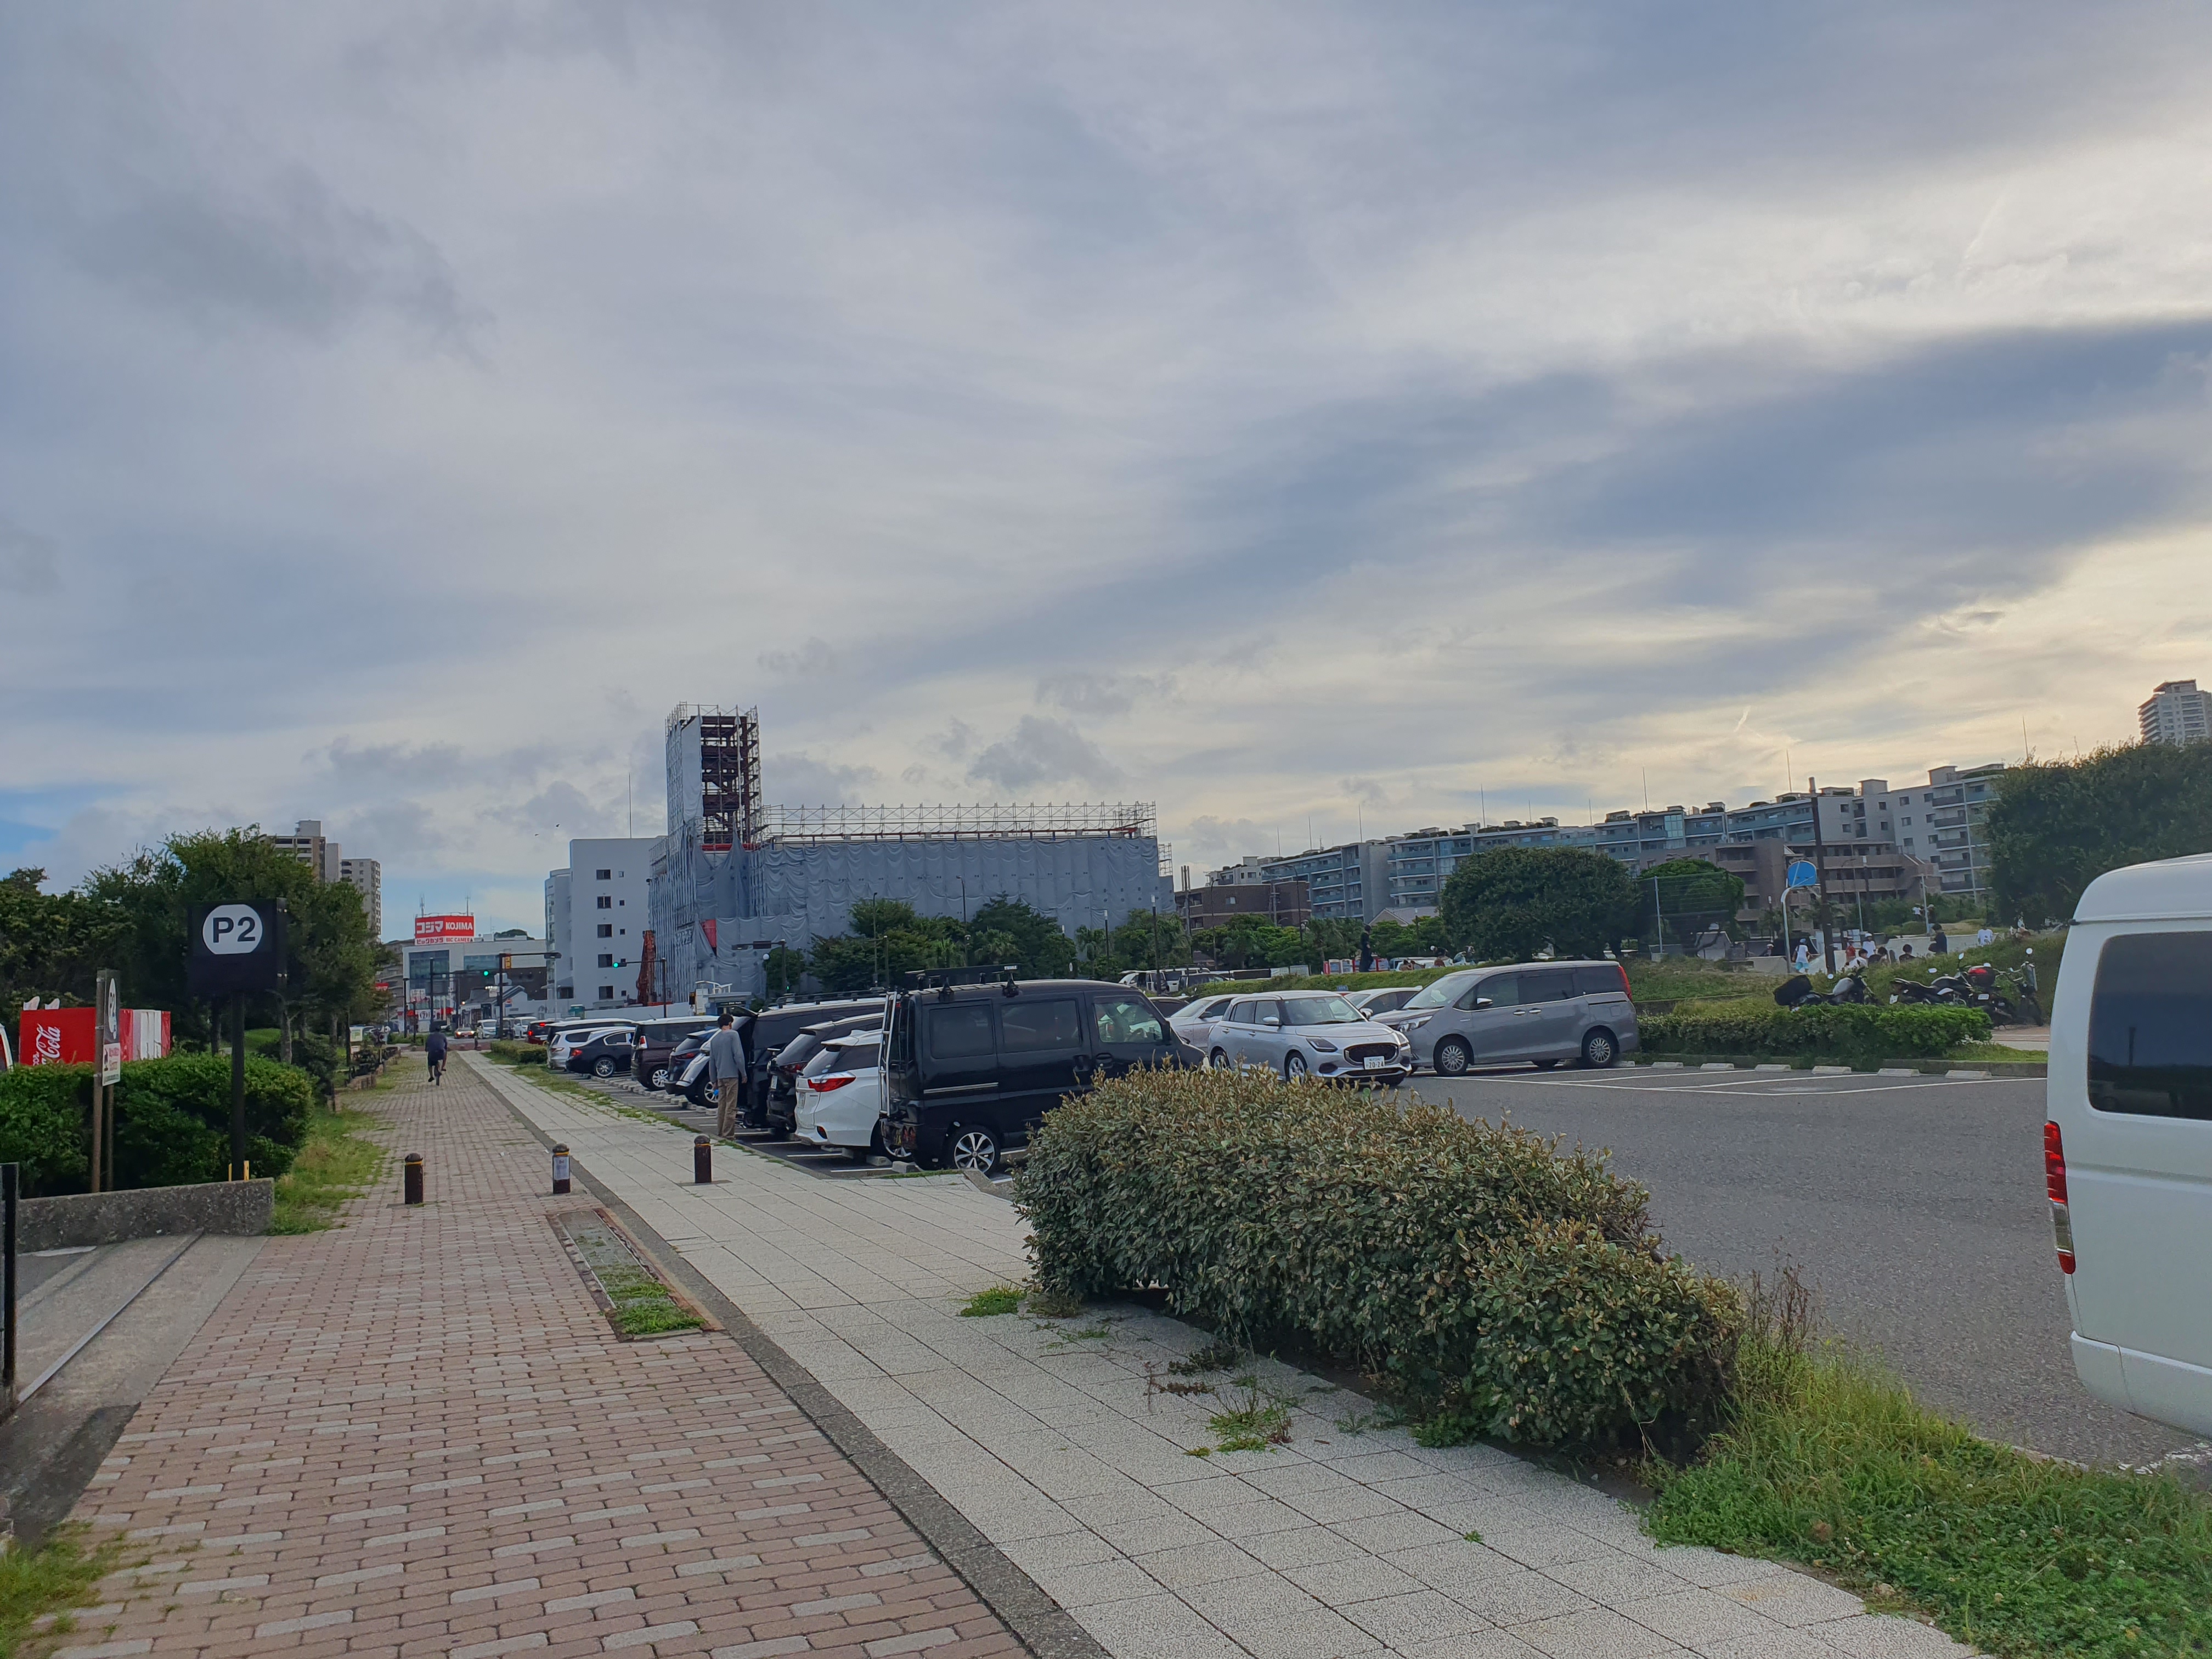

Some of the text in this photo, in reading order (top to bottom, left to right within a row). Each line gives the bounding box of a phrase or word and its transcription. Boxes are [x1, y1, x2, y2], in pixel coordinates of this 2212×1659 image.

[213, 917, 256, 943] P2
[416, 921, 443, 934] コジマ
[445, 922, 473, 930] KOJIMA
